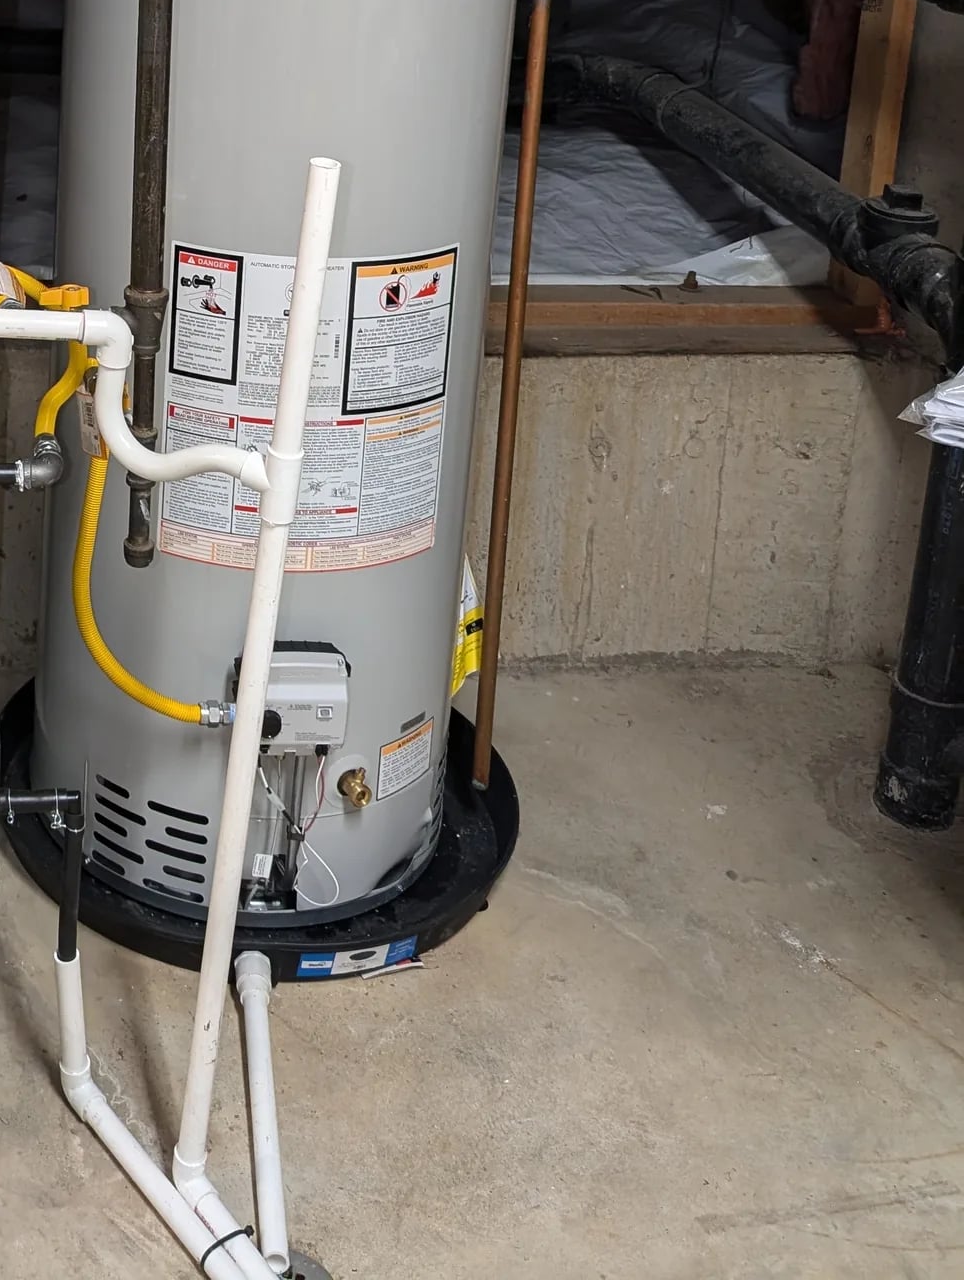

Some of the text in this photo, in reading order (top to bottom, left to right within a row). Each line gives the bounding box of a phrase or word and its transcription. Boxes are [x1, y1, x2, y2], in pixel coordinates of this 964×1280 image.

[198, 258, 230, 270] DANGER
[250, 261, 279, 269] AUTOMATIC
[399, 263, 428, 273] WARNING
